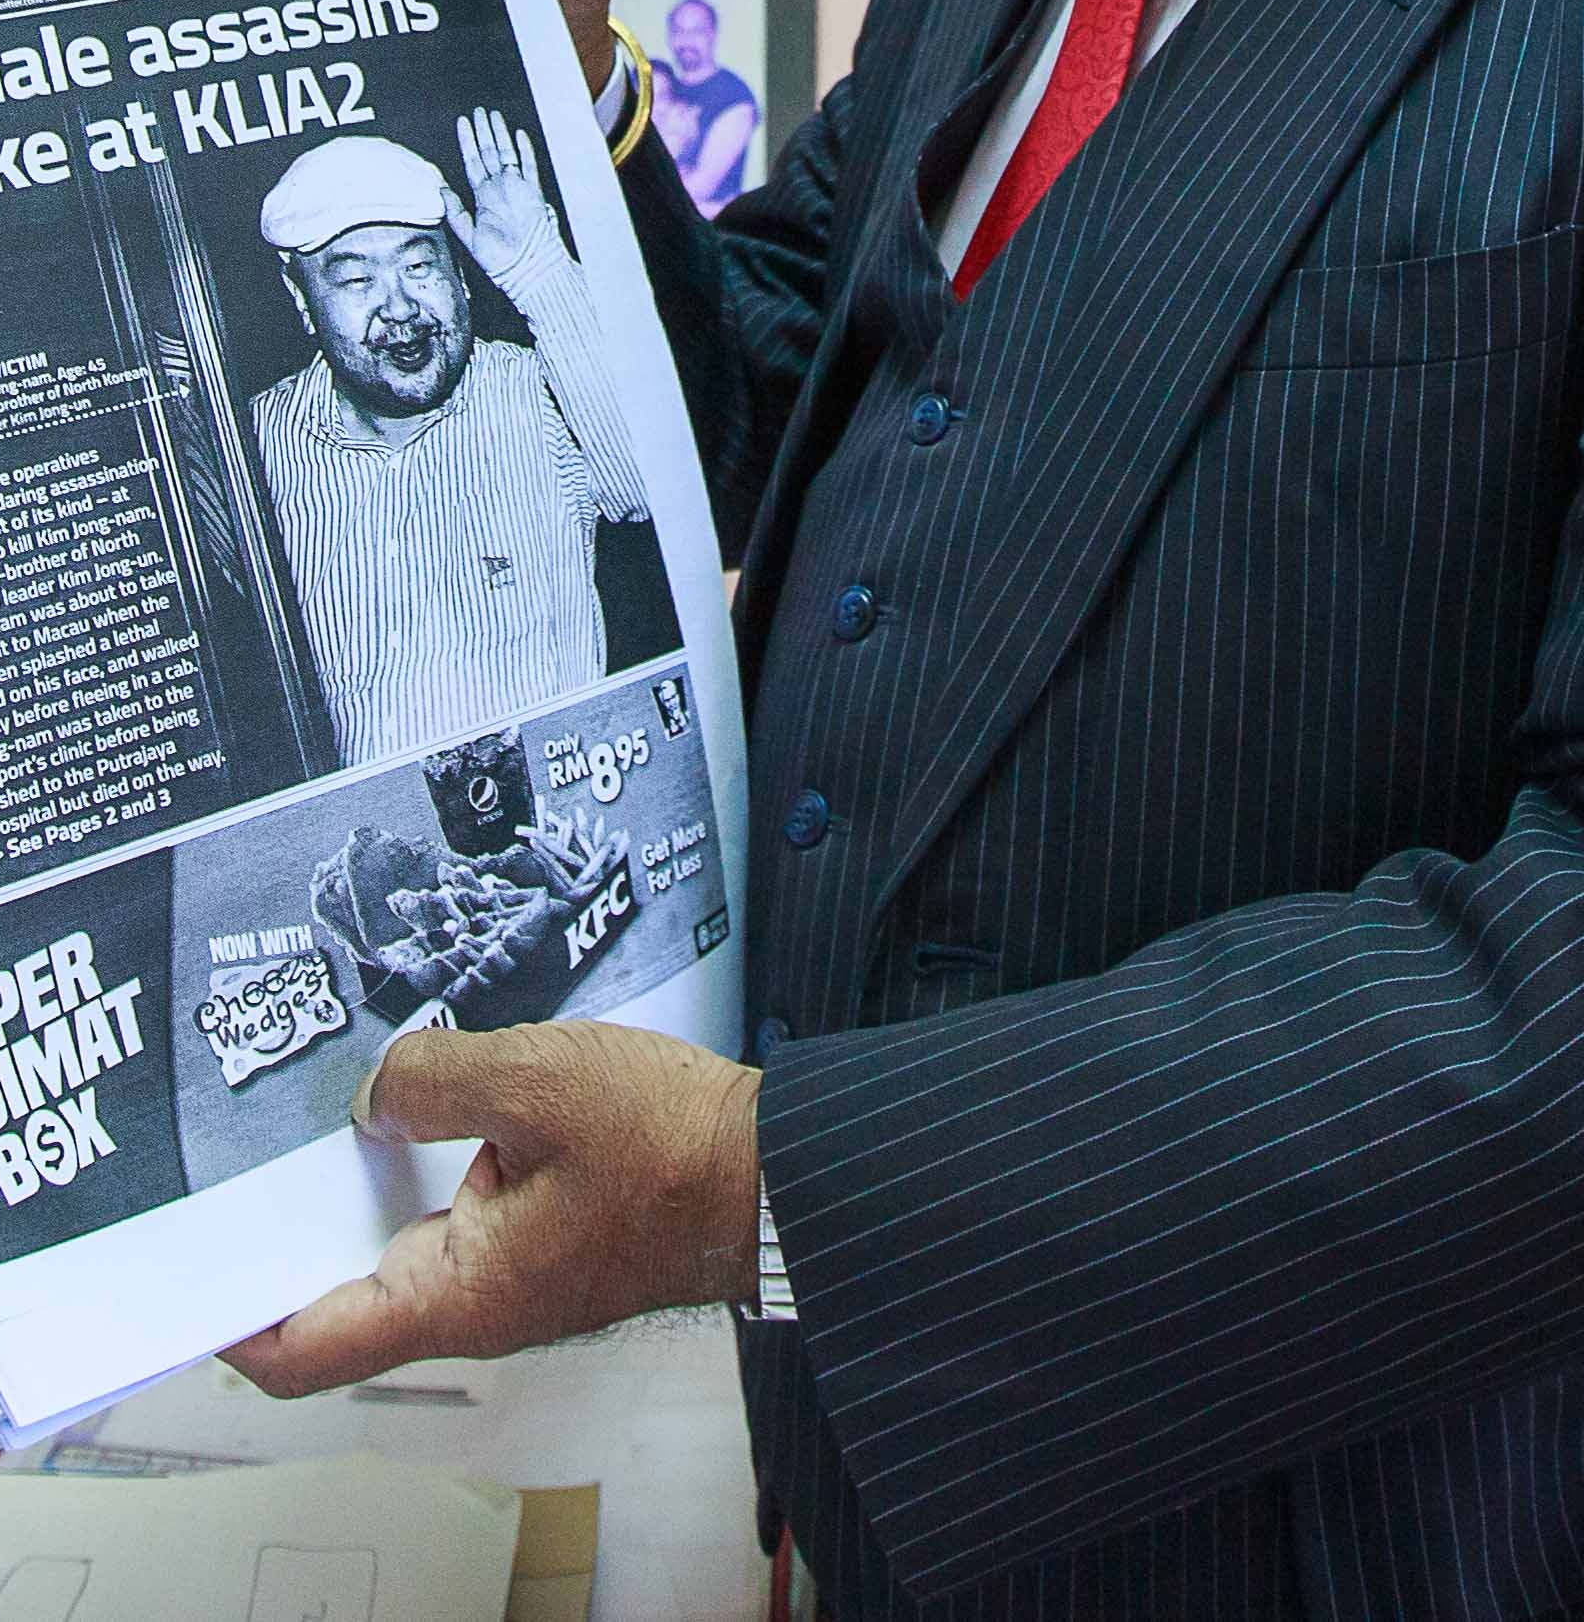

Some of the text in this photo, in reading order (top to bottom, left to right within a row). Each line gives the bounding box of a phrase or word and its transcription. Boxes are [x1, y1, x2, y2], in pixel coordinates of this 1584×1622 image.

[86, 100, 166, 174] at
[173, 62, 376, 154] KLIA2
[46, 384, 61, 400] of
[62, 376, 102, 396] North
[102, 367, 149, 385] Korean
[88, 357, 106, 372] 45
[9, 411, 38, 427] Kim
[38, 398, 91, 419] Jong-un
[12, 449, 100, 484] operatives
[50, 455, 161, 496] assassination
[7, 533, 34, 555] kill
[35, 527, 70, 547] Kim
[71, 506, 156, 539] Jong-nam,
[10, 510, 29, 530] of
[31, 507, 55, 525] its
[55, 493, 93, 518] kind
[111, 485, 130, 504] at
[70, 541, 88, 562] of
[90, 529, 140, 556] North
[1, 579, 55, 606] leader
[57, 569, 92, 590] Kim
[93, 550, 164, 581] Jong-un.
[29, 601, 66, 622] was
[68, 584, 118, 611] about
[118, 580, 138, 597] to
[139, 561, 180, 590] take
[11, 636, 31, 652] to
[32, 618, 90, 646] Macau
[91, 604, 140, 628] when
[141, 595, 170, 614] the
[20, 636, 97, 676] splashed
[99, 637, 112, 651] a
[112, 618, 160, 647] lethal
[9, 685, 32, 703] on
[33, 675, 61, 695] his
[63, 664, 105, 686] face,
[107, 648, 139, 673] and
[140, 630, 200, 663] walked
[12, 698, 70, 727] before
[71, 680, 131, 709] fleeing
[130, 673, 149, 690] in
[150, 670, 163, 684] a
[164, 657, 199, 680] cab.
[49, 739, 93, 766] clinic
[94, 723, 151, 751] before
[151, 708, 200, 733] being
[55, 717, 92, 738] was
[94, 701, 142, 726] taken
[143, 694, 163, 711] to
[165, 685, 194, 704] the
[42, 777, 62, 794] to
[63, 766, 95, 787] the
[96, 740, 177, 777] Putrajaya
[544, 731, 582, 759] Only
[58, 790, 91, 815] but
[92, 776, 130, 803] died
[132, 772, 155, 790] on
[156, 762, 186, 782] the
[186, 749, 226, 772] way.
[6, 788, 171, 858] See Pages 2 and 3
[642, 821, 707, 868] Get More
[647, 854, 703, 895] For Less
[209, 924, 314, 964] NOW WITH
[565, 872, 632, 970] KFC
[216, 970, 322, 1054] Wedges
